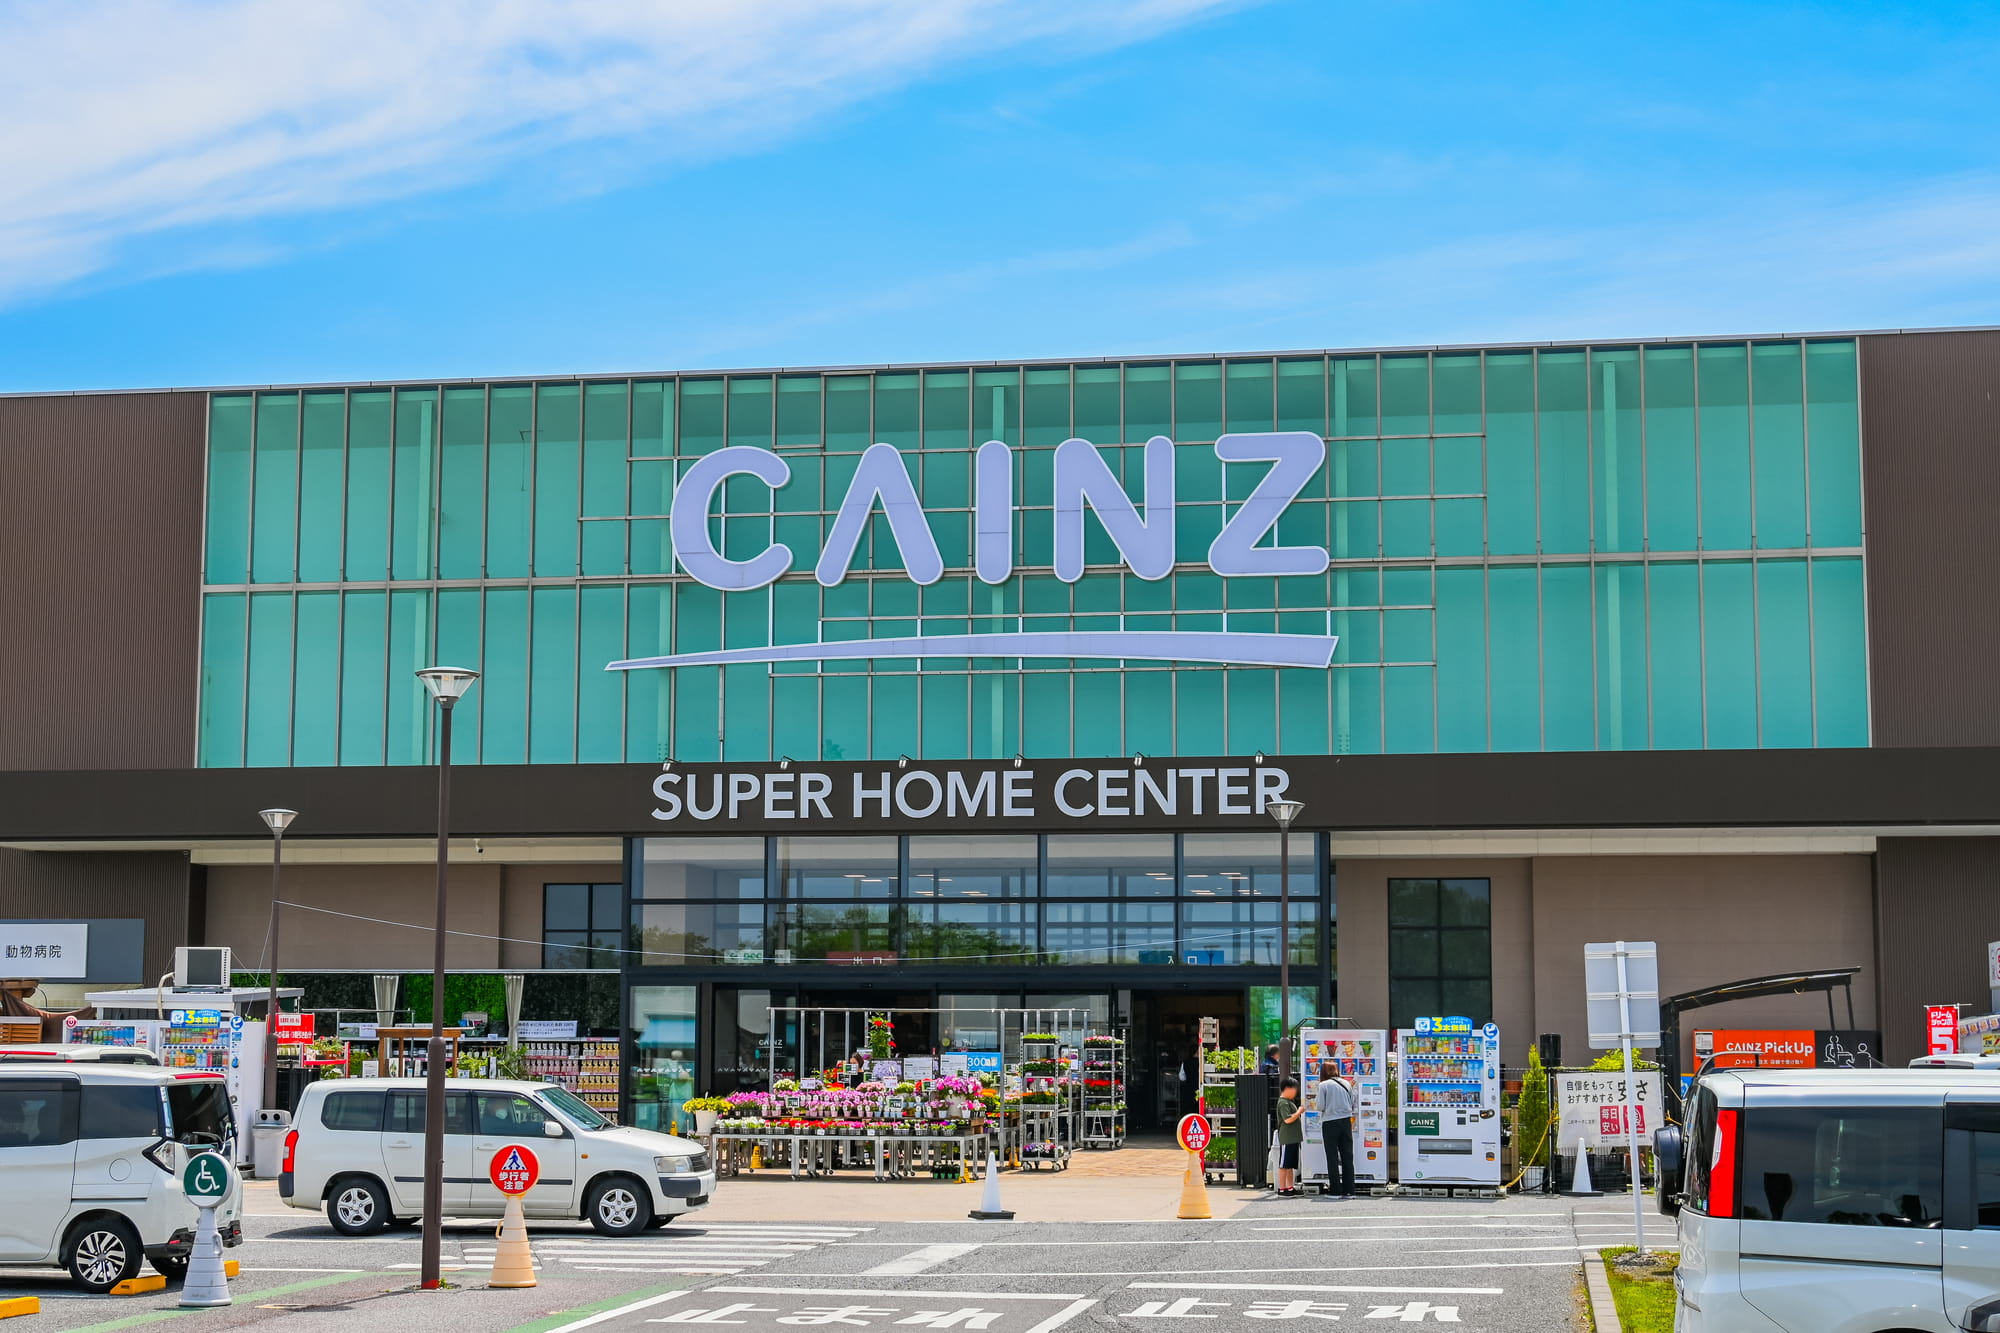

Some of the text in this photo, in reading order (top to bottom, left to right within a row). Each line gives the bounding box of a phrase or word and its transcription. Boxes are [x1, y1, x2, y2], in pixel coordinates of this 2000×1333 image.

[670, 431, 1330, 592] CAINZ
[652, 767, 1291, 822] SUPER HOME CENTER
[6, 944, 62, 958] 動物病院
[1930, 1011, 1952, 1019] ドリーム
[1725, 1042, 1762, 1051] CAINZ
[1566, 1080, 1614, 1091] 自信をもって
[1567, 1093, 1614, 1104] おすすめする
[1601, 1108, 1618, 1120] 毎日
[1601, 1122, 1619, 1133] 安い
[499, 1171, 529, 1181] 歩行者
[504, 1181, 524, 1190] 注意
[1118, 1298, 1462, 1322] 止まれ
[645, 1303, 1004, 1329] 止まれ
